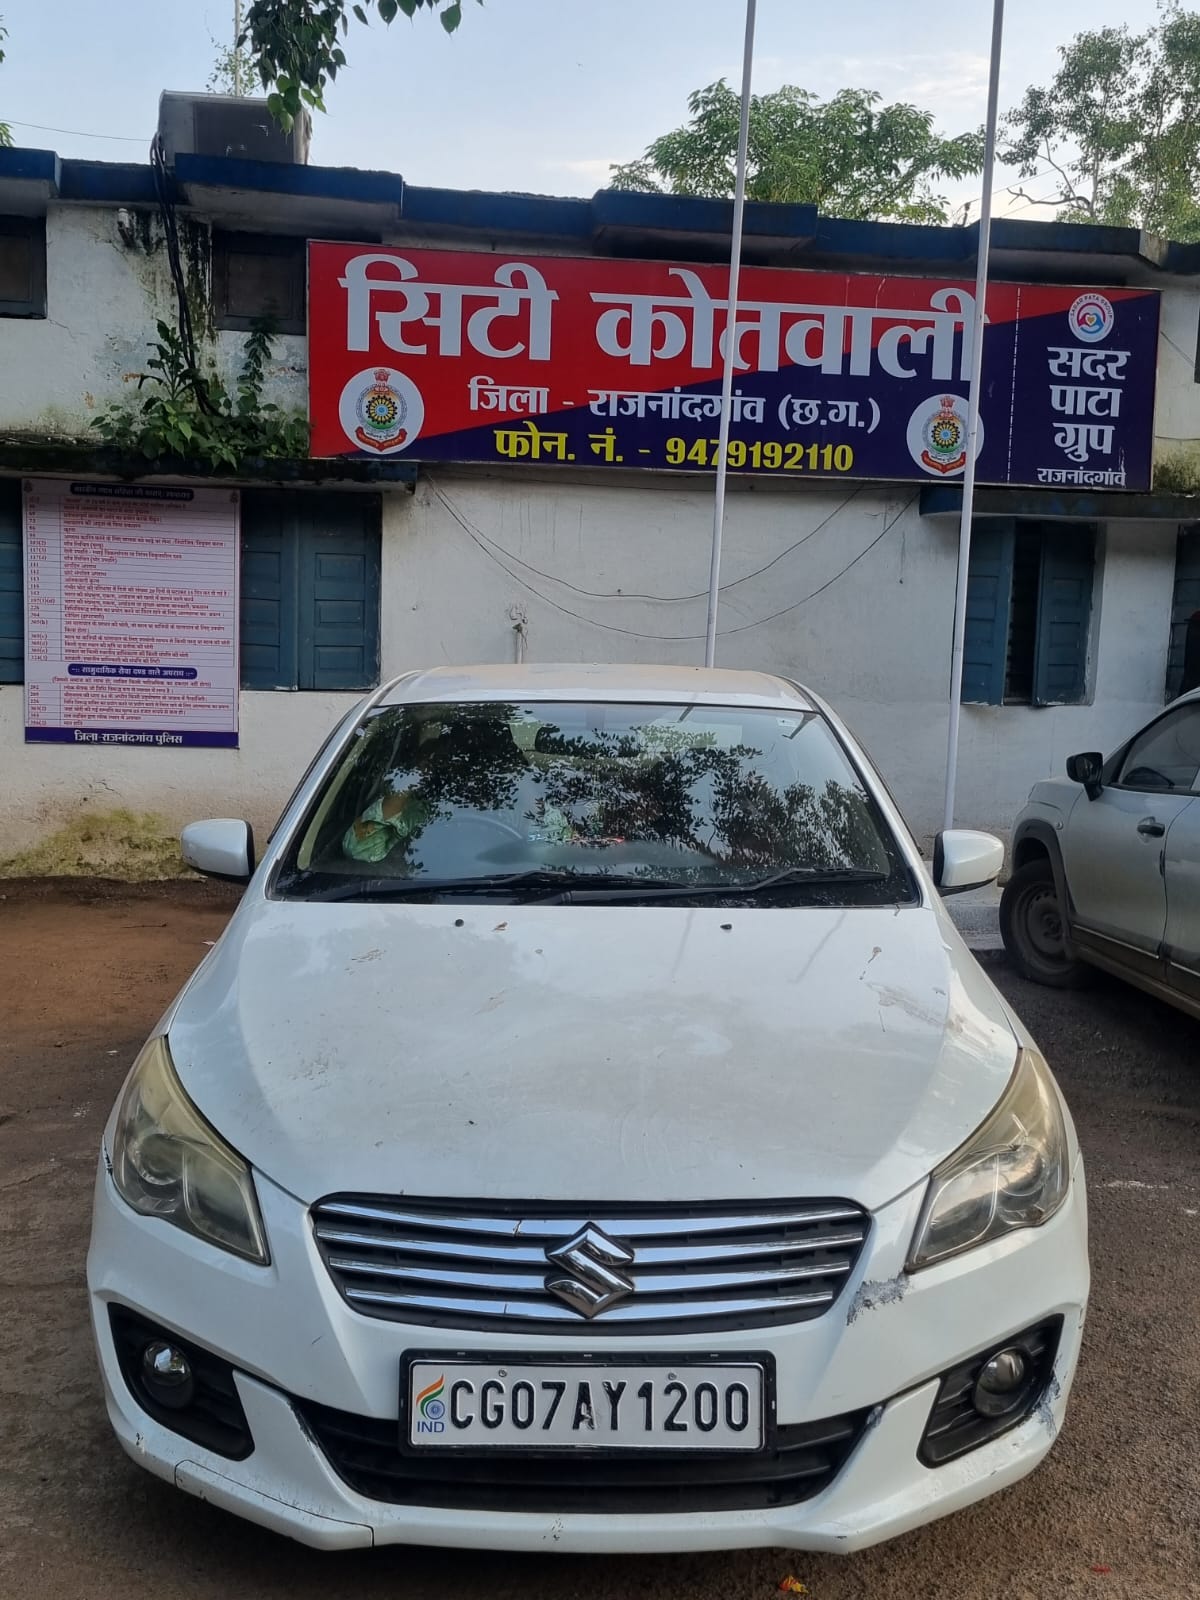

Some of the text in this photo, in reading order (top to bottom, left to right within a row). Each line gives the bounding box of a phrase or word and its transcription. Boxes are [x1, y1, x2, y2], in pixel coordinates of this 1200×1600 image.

[337, 253, 991, 381] सिटी कोतवाली
[1046, 346, 1131, 381] सदर
[468, 375, 550, 414] जिला
[587, 386, 765, 424] राजनांदगांव
[778, 394, 881, 434] (छ.ग.)
[1050, 385, 1123, 418] पाटा
[493, 421, 575, 461] फोन.
[588, 428, 623, 463] नं.
[666, 437, 854, 472] 9479192110
[1052, 422, 1115, 462] ग्रुप
[155, 732, 183, 745] पुलिस
[450, 1380, 750, 1432] CG07AY1200
[417, 1421, 445, 1433] IND
